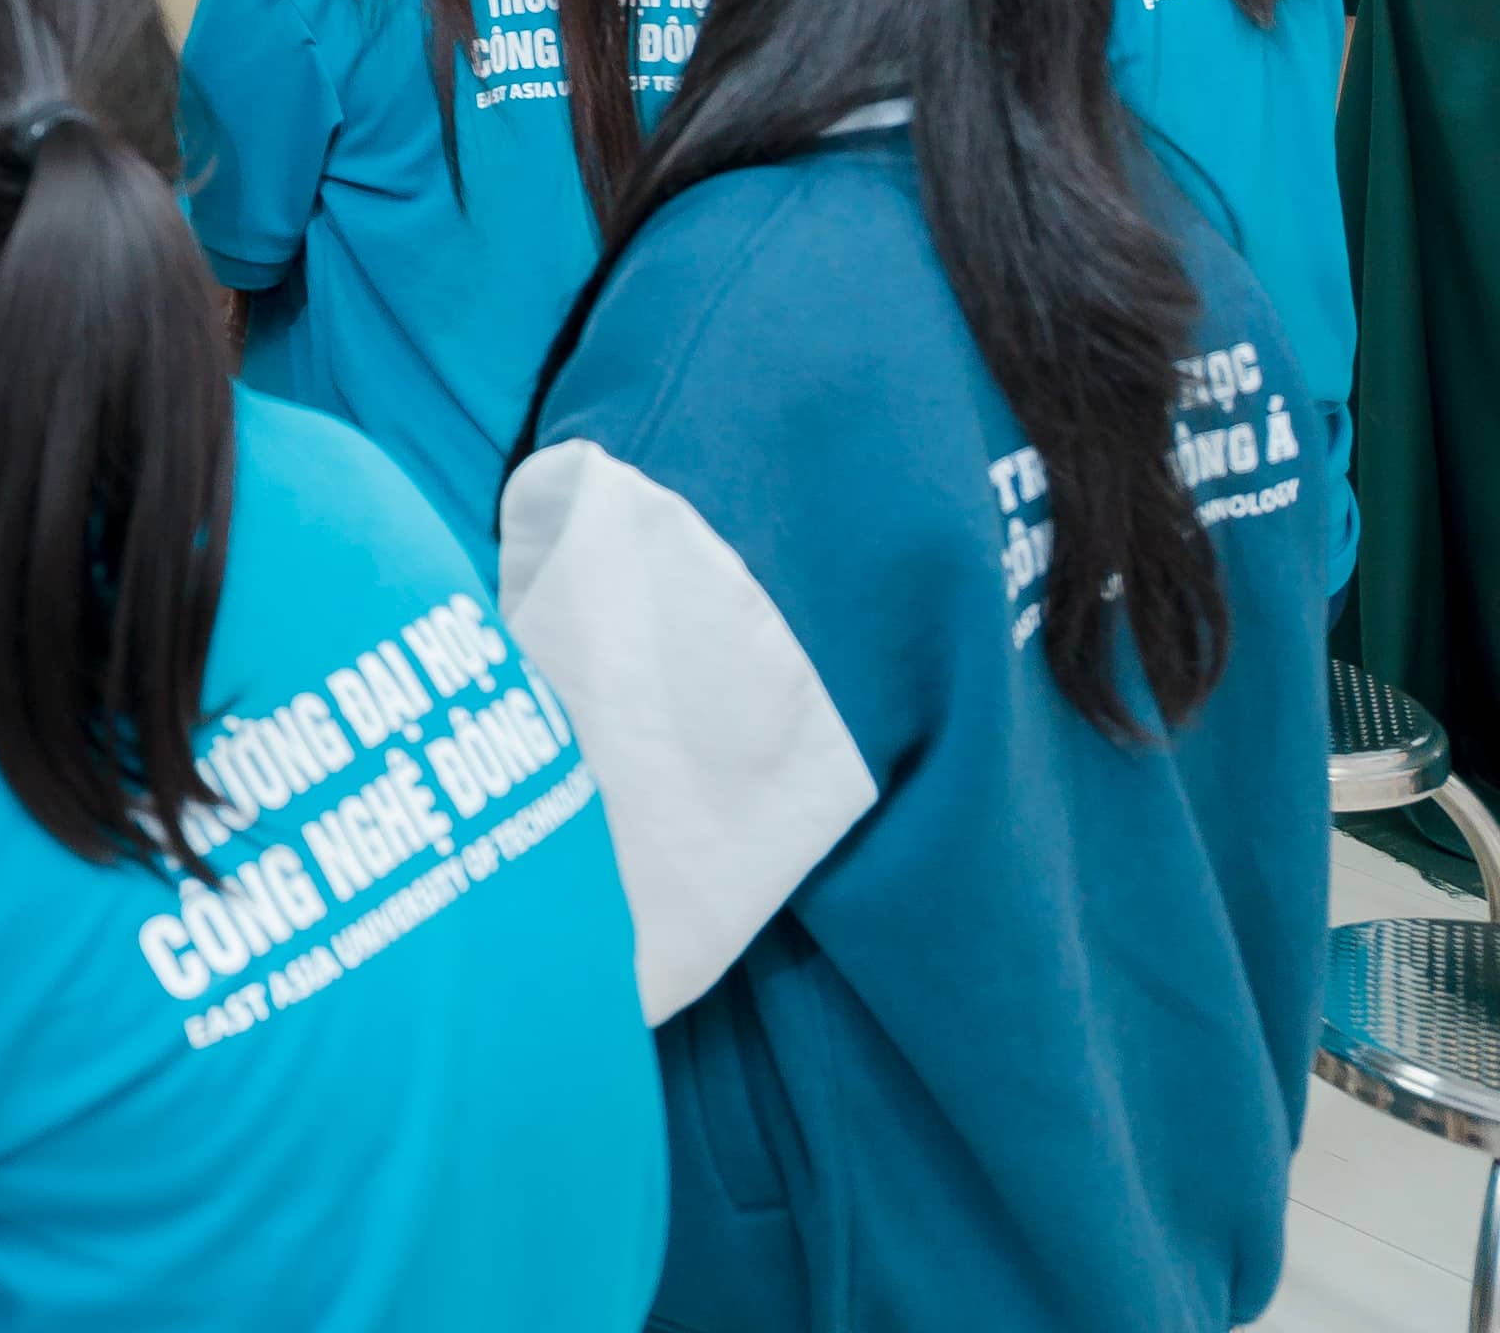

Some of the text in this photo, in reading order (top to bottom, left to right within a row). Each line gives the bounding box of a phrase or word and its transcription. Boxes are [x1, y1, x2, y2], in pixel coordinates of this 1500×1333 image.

[470, 26, 560, 79] CÔNG
[510, 82, 557, 100] ASIA
[1266, 394, 1299, 464] Á
[325, 639, 434, 750] ĐẠI
[401, 592, 508, 695] HỌC
[138, 844, 328, 1000] CÔNG
[301, 747, 454, 903] NGHỆ
[424, 688, 561, 820] ĐÔNG
[184, 982, 270, 1049] EAST
[268, 945, 344, 1010] ASIA
[331, 855, 471, 969] UNIVERSITY
[460, 834, 500, 883] OF
